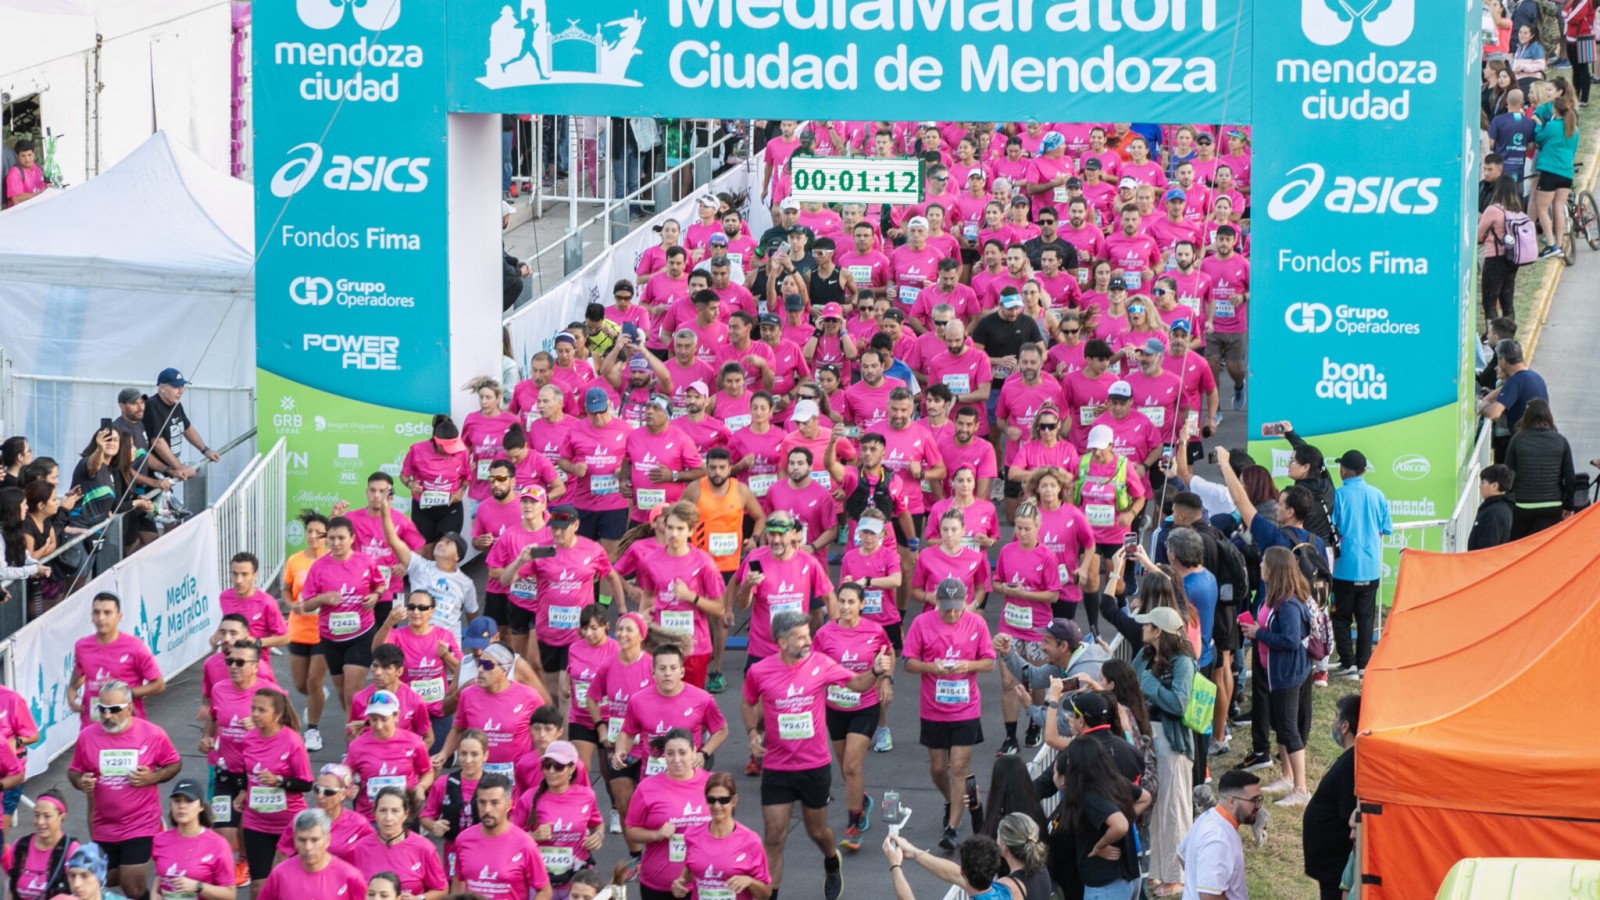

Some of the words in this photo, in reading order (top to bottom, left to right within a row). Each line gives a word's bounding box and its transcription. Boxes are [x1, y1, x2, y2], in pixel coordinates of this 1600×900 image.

[275, 37, 422, 67] mendoza
[669, 40, 858, 90] Ciudad
[874, 43, 943, 91] de
[961, 44, 1218, 93] Mendoza
[1277, 52, 1437, 84] mendoza
[299, 72, 399, 102] ciudad
[1301, 89, 1409, 120] ciudad
[323, 155, 430, 192] asics
[794, 169, 918, 193] 00:01:12
[1324, 176, 1441, 214] asics
[282, 225, 359, 248] Fondos
[366, 227, 421, 250] Fima
[1279, 249, 1361, 273] Fondos
[1369, 251, 1428, 275] Fima
[336, 279, 386, 294] Grupo
[336, 293, 415, 308] Operadores
[1335, 305, 1388, 320] Grupo
[1335, 319, 1420, 336] Operadores
[303, 334, 400, 353] POWER
[342, 352, 398, 370] ADE
[1316, 379, 1388, 405] aqua
[273, 414, 303, 427] GRB
[395, 421, 432, 435] osde
[1389, 497, 1435, 516] manda
[166, 573, 196, 611] Media
[167, 592, 209, 637] Maratón
